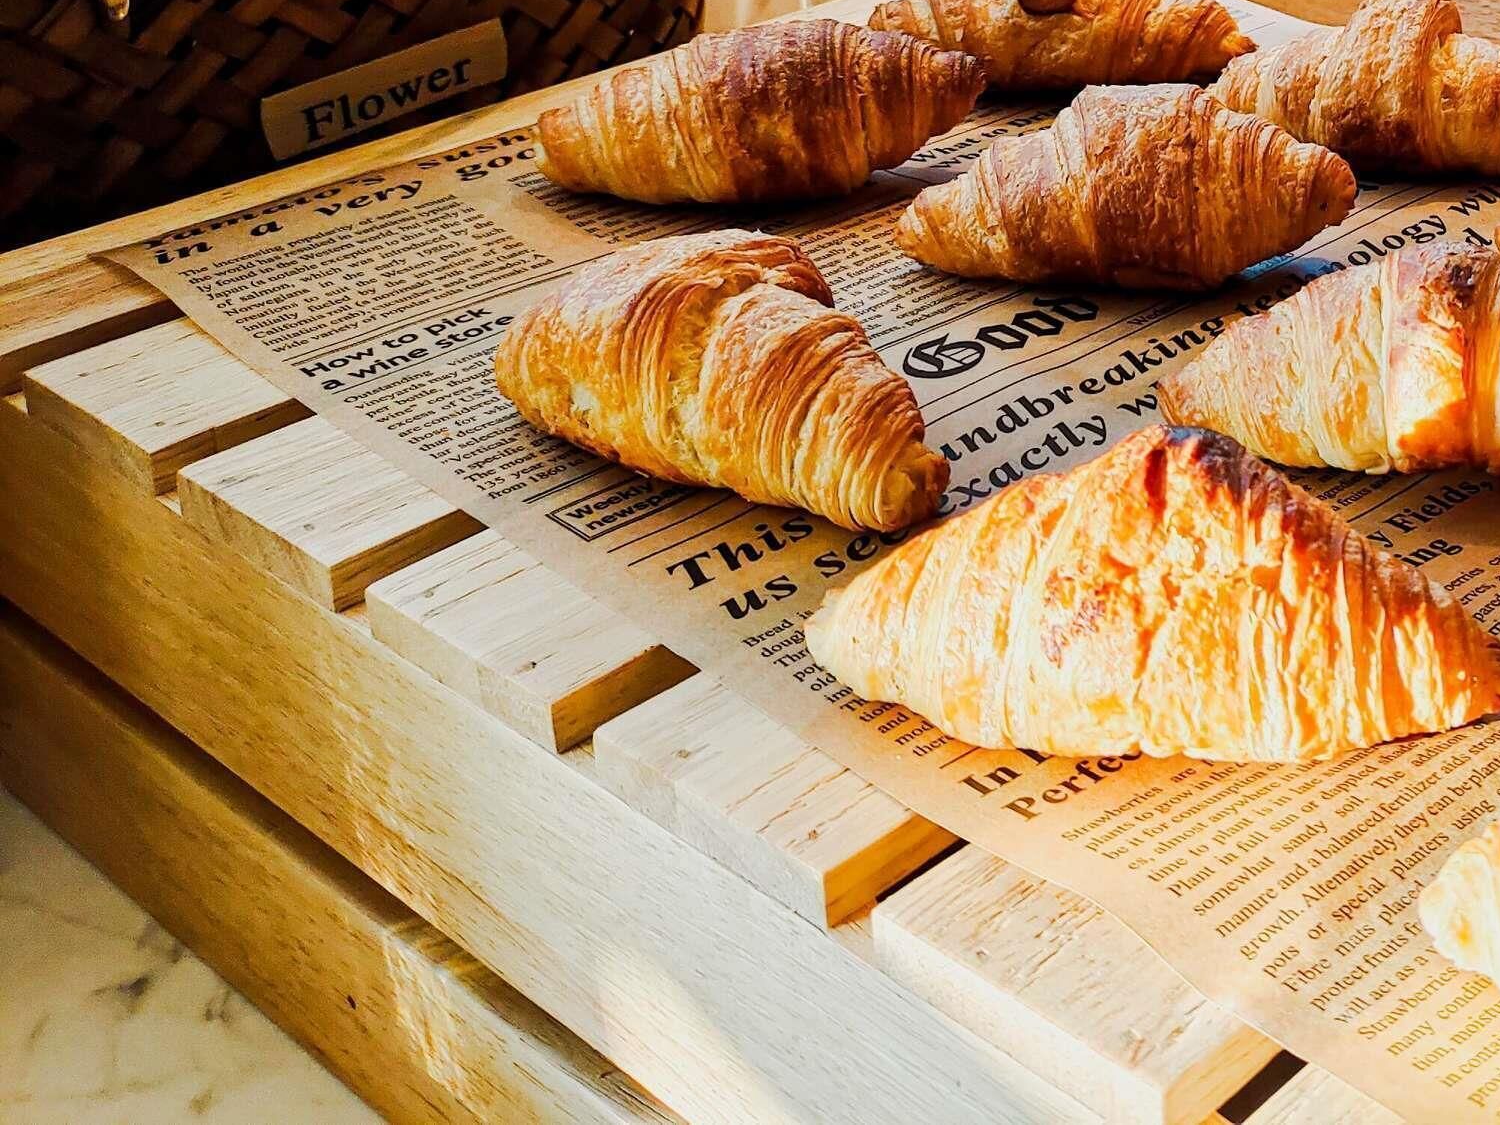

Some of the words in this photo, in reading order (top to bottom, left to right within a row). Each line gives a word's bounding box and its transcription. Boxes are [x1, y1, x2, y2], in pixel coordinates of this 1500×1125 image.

[301, 58, 472, 144] Flower
[982, 128, 1009, 139] to
[154, 239, 213, 266] in
[250, 219, 283, 237] a
[313, 179, 424, 219] very
[299, 347, 374, 382] How
[382, 331, 419, 354] to
[428, 306, 493, 343] pick
[322, 378, 341, 393] a
[346, 347, 430, 390] wine
[439, 315, 515, 354] store
[342, 370, 435, 404] Outstanding
[1387, 475, 1494, 536] Fields,
[666, 513, 814, 592] This
[719, 575, 798, 620] us
[960, 765, 1023, 797] In
[1440, 753, 1472, 775] aids
[1378, 771, 1443, 816] fertilizer
[1165, 865, 1217, 899] Plant
[1217, 852, 1240, 866] in
[1235, 830, 1270, 853] full
[1269, 813, 1301, 833] sun
[1300, 799, 1320, 814] or
[1319, 764, 1380, 801] dappled
[1192, 855, 1276, 917] somewhat
[1281, 819, 1329, 854] sandy
[1333, 795, 1371, 819] soil.
[1374, 770, 1407, 790] The
[1410, 734, 1468, 768] addition
[1314, 810, 1386, 860] balanced
[1239, 909, 1305, 961] growth.
[1393, 813, 1430, 839] they
[1426, 795, 1457, 816] can
[1446, 781, 1473, 797] be
[1261, 945, 1301, 979] pots
[1306, 921, 1329, 941] or
[1330, 876, 1390, 923] special
[1389, 831, 1450, 881] planters
[1450, 799, 1497, 831] using
[1276, 863, 1310, 891] and
[1307, 857, 1323, 869] a
[1213, 887, 1279, 939] manure
